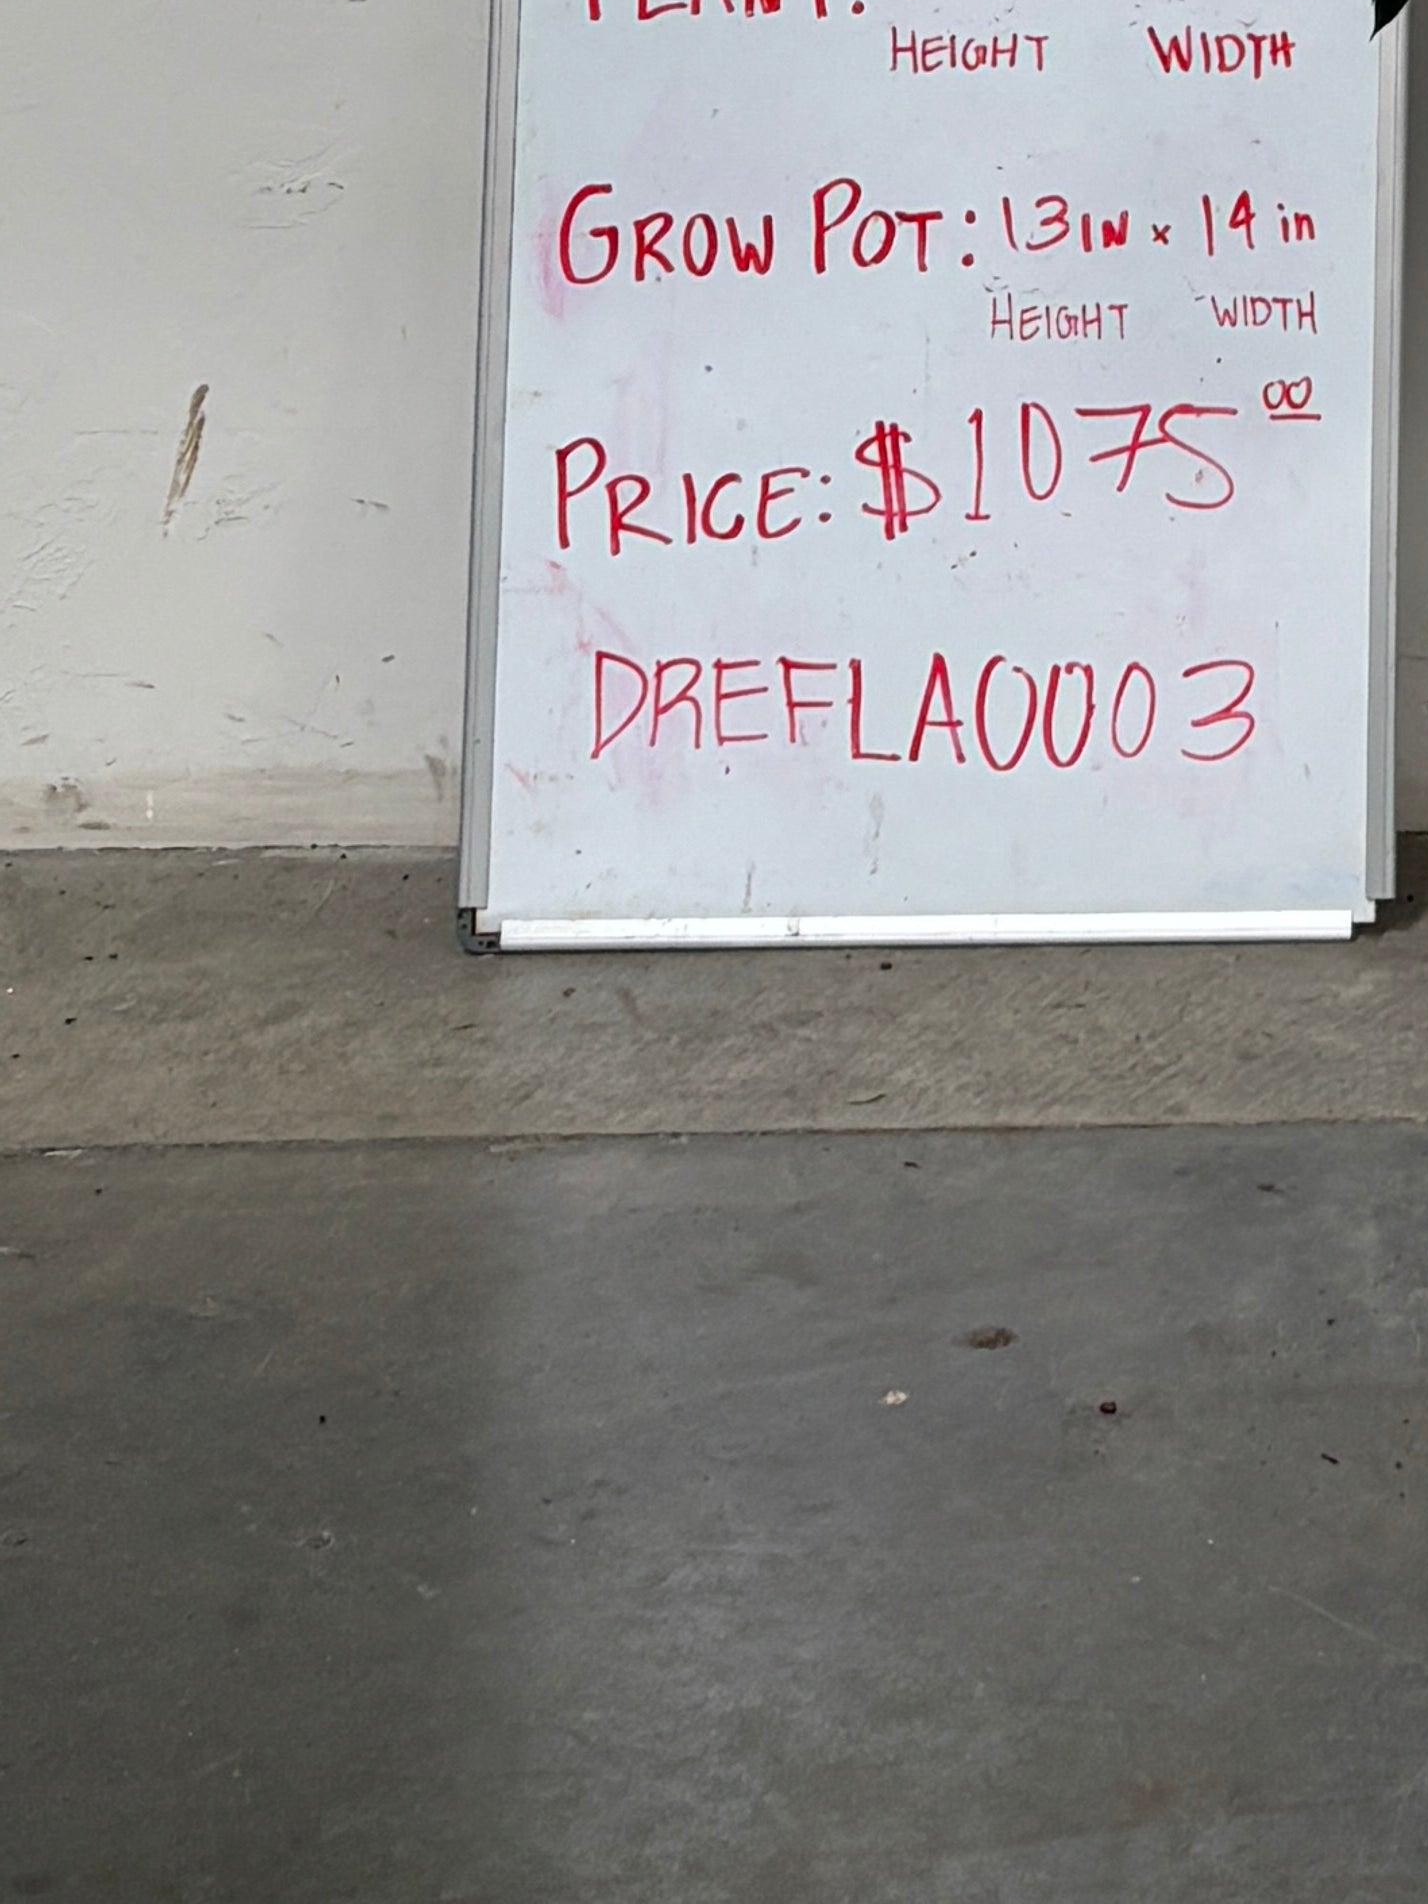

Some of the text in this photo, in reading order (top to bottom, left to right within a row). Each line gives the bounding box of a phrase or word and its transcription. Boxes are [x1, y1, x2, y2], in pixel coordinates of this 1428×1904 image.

[890, 25, 1296, 80] HEIGHT WIDTH
[558, 183, 773, 285] GROW
[812, 178, 977, 274] POT:
[1202, 189, 1256, 257] 14
[991, 291, 1318, 341] HEIGHT WIDTH
[555, 437, 833, 555] PRICE:
[589, 650, 1256, 772] DREFLA0003
